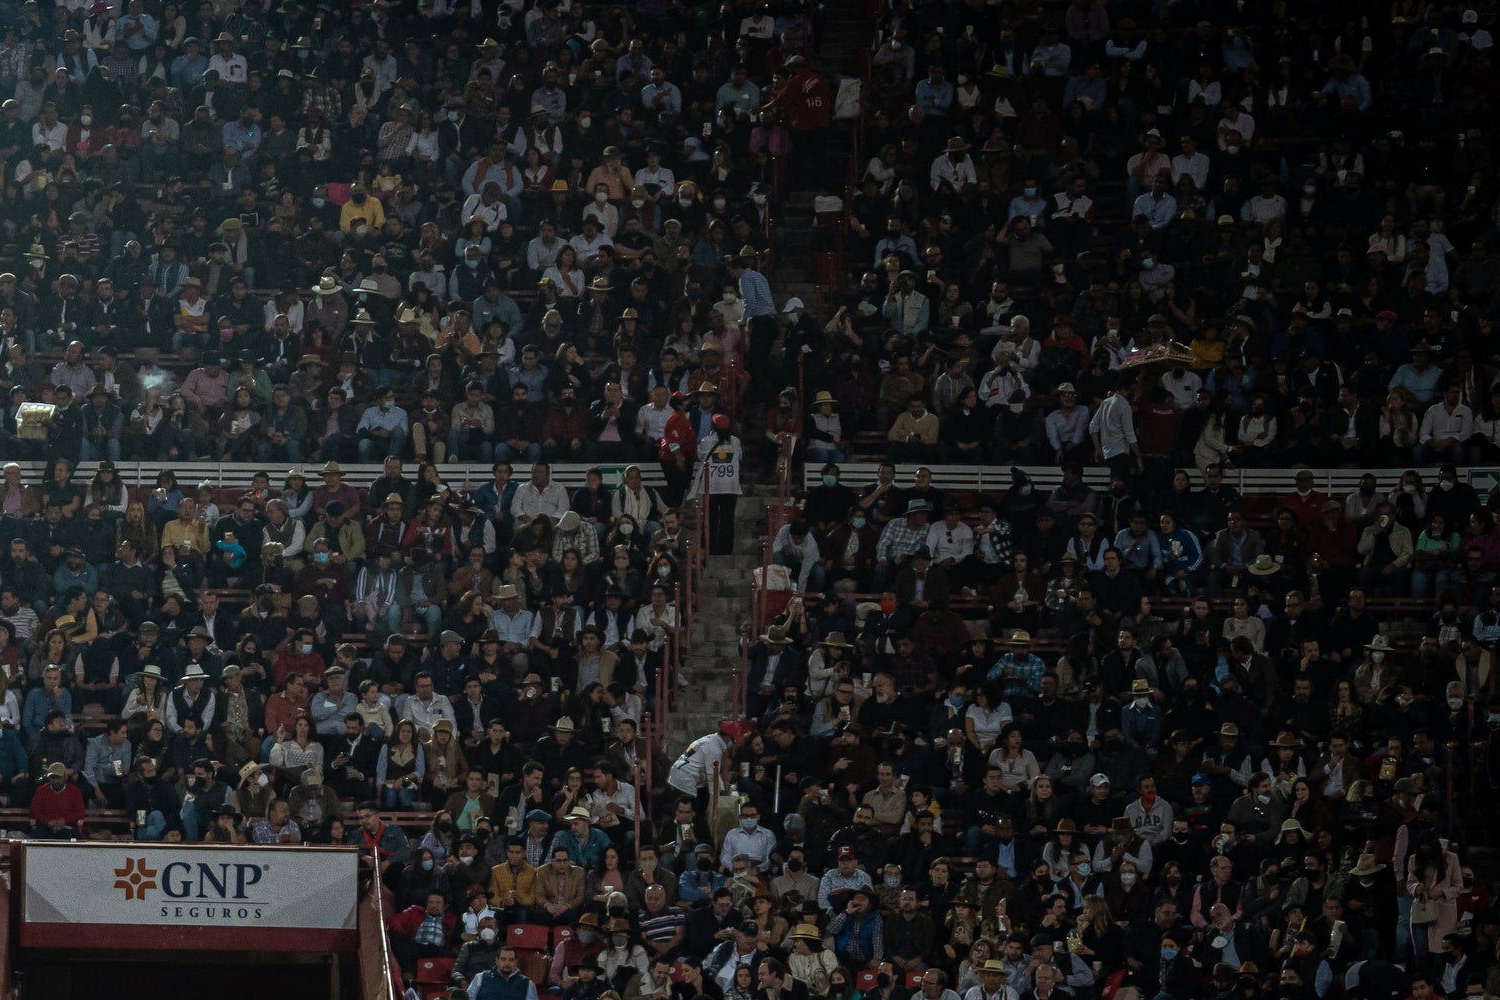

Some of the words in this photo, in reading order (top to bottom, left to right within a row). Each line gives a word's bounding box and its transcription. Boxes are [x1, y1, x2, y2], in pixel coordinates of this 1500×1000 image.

[710, 465, 734, 479] 799
[1135, 815, 1161, 827] GAP
[161, 862, 263, 899] GNP
[160, 907, 263, 919] SEGUROS
